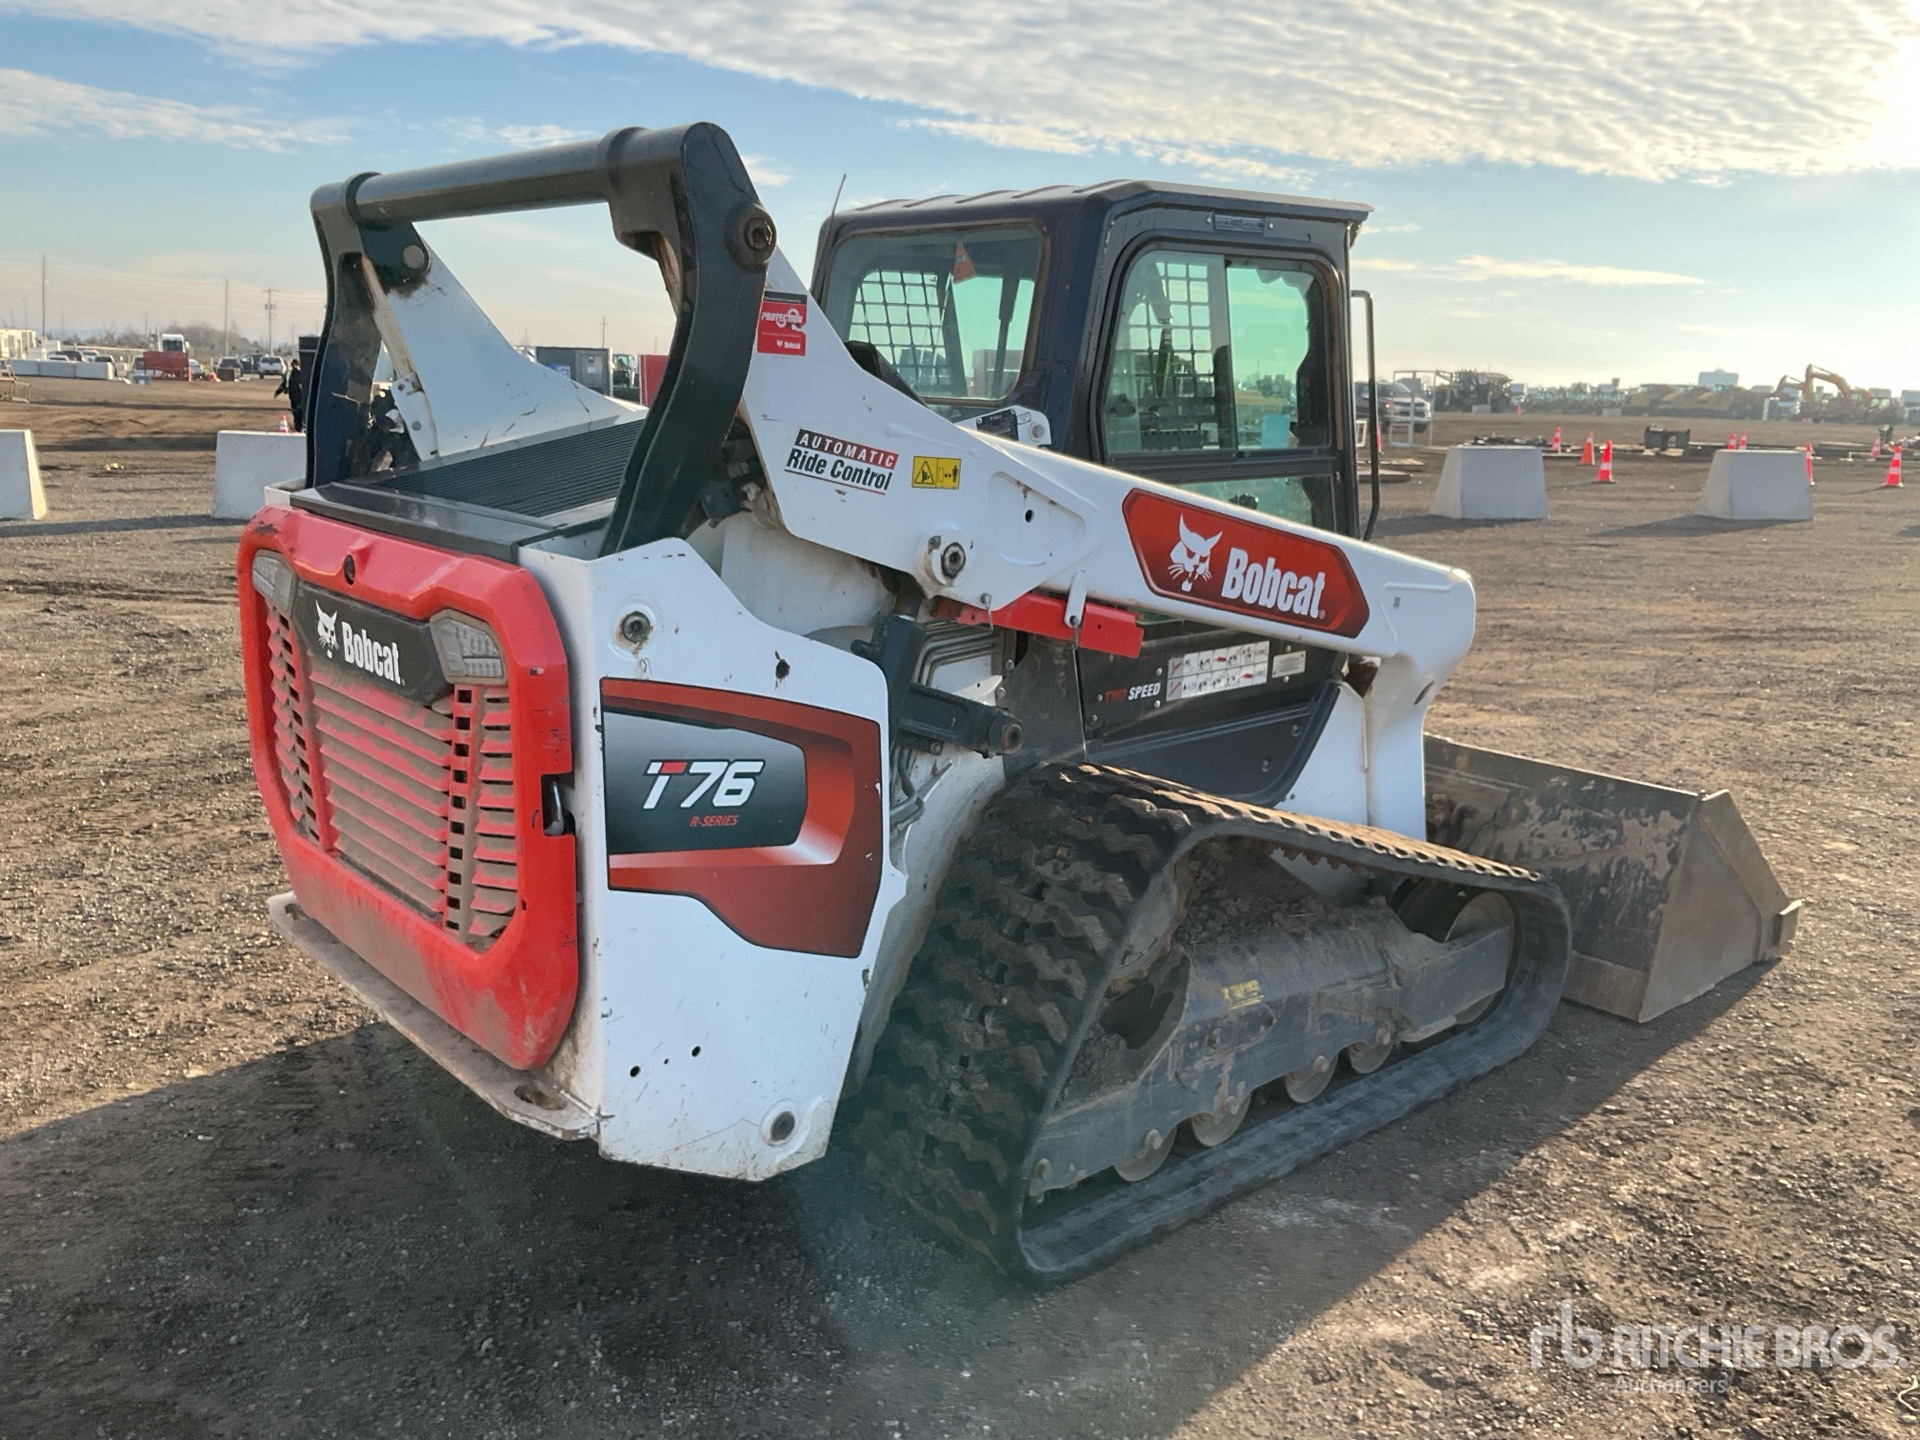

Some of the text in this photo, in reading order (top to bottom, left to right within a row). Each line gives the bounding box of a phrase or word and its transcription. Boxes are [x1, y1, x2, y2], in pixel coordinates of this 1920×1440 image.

[786, 448, 893, 491] Ride Control
[799, 433, 894, 468] AUTOMATIC
[1221, 547, 1325, 619] Bobcat
[341, 621, 401, 685] Bobcat
[1128, 682, 1161, 700] SPEED
[643, 761, 765, 809] T76
[689, 815, 739, 827] R-SERIES
